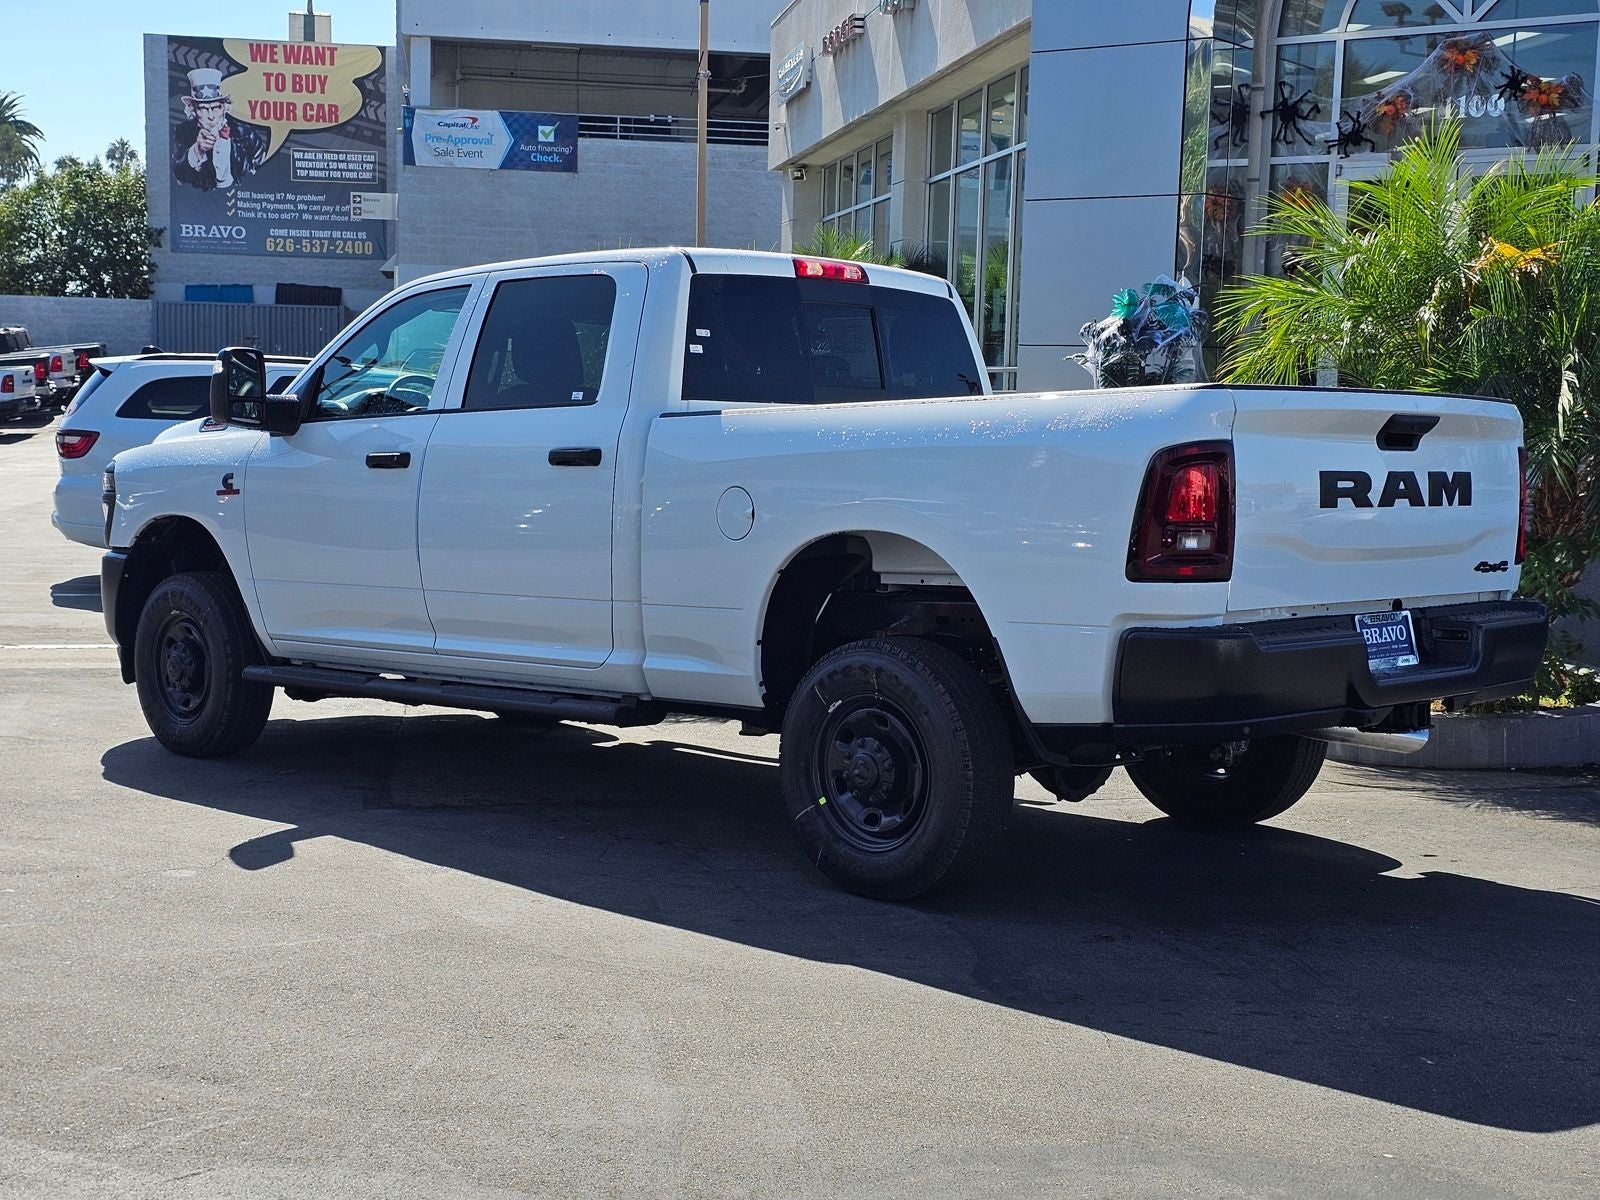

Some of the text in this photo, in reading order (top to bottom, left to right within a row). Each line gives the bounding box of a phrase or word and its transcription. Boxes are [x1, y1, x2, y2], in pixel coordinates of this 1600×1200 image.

[249, 42, 338, 66] WE WANT
[263, 72, 328, 95] TO BUY
[248, 100, 339, 124] YOUR CAR
[424, 133, 493, 146] Pre-Approval
[293, 151, 304, 159] WE
[434, 147, 484, 159] Sale Event
[538, 144, 573, 154] financing?
[530, 153, 563, 163] Check.
[308, 170, 330, 178] MONEY
[252, 192, 274, 200] leasing
[237, 200, 260, 210] Making
[180, 224, 246, 239] BRAVO
[270, 228, 367, 240] COME INSIDE TODAY OR CALL US
[266, 237, 373, 255] 626-537-2400
[1319, 470, 1472, 509] RAM
[1473, 560, 1509, 573] 4x4
[1369, 613, 1396, 623] BRAVO
[1362, 625, 1407, 645] BRAVO
